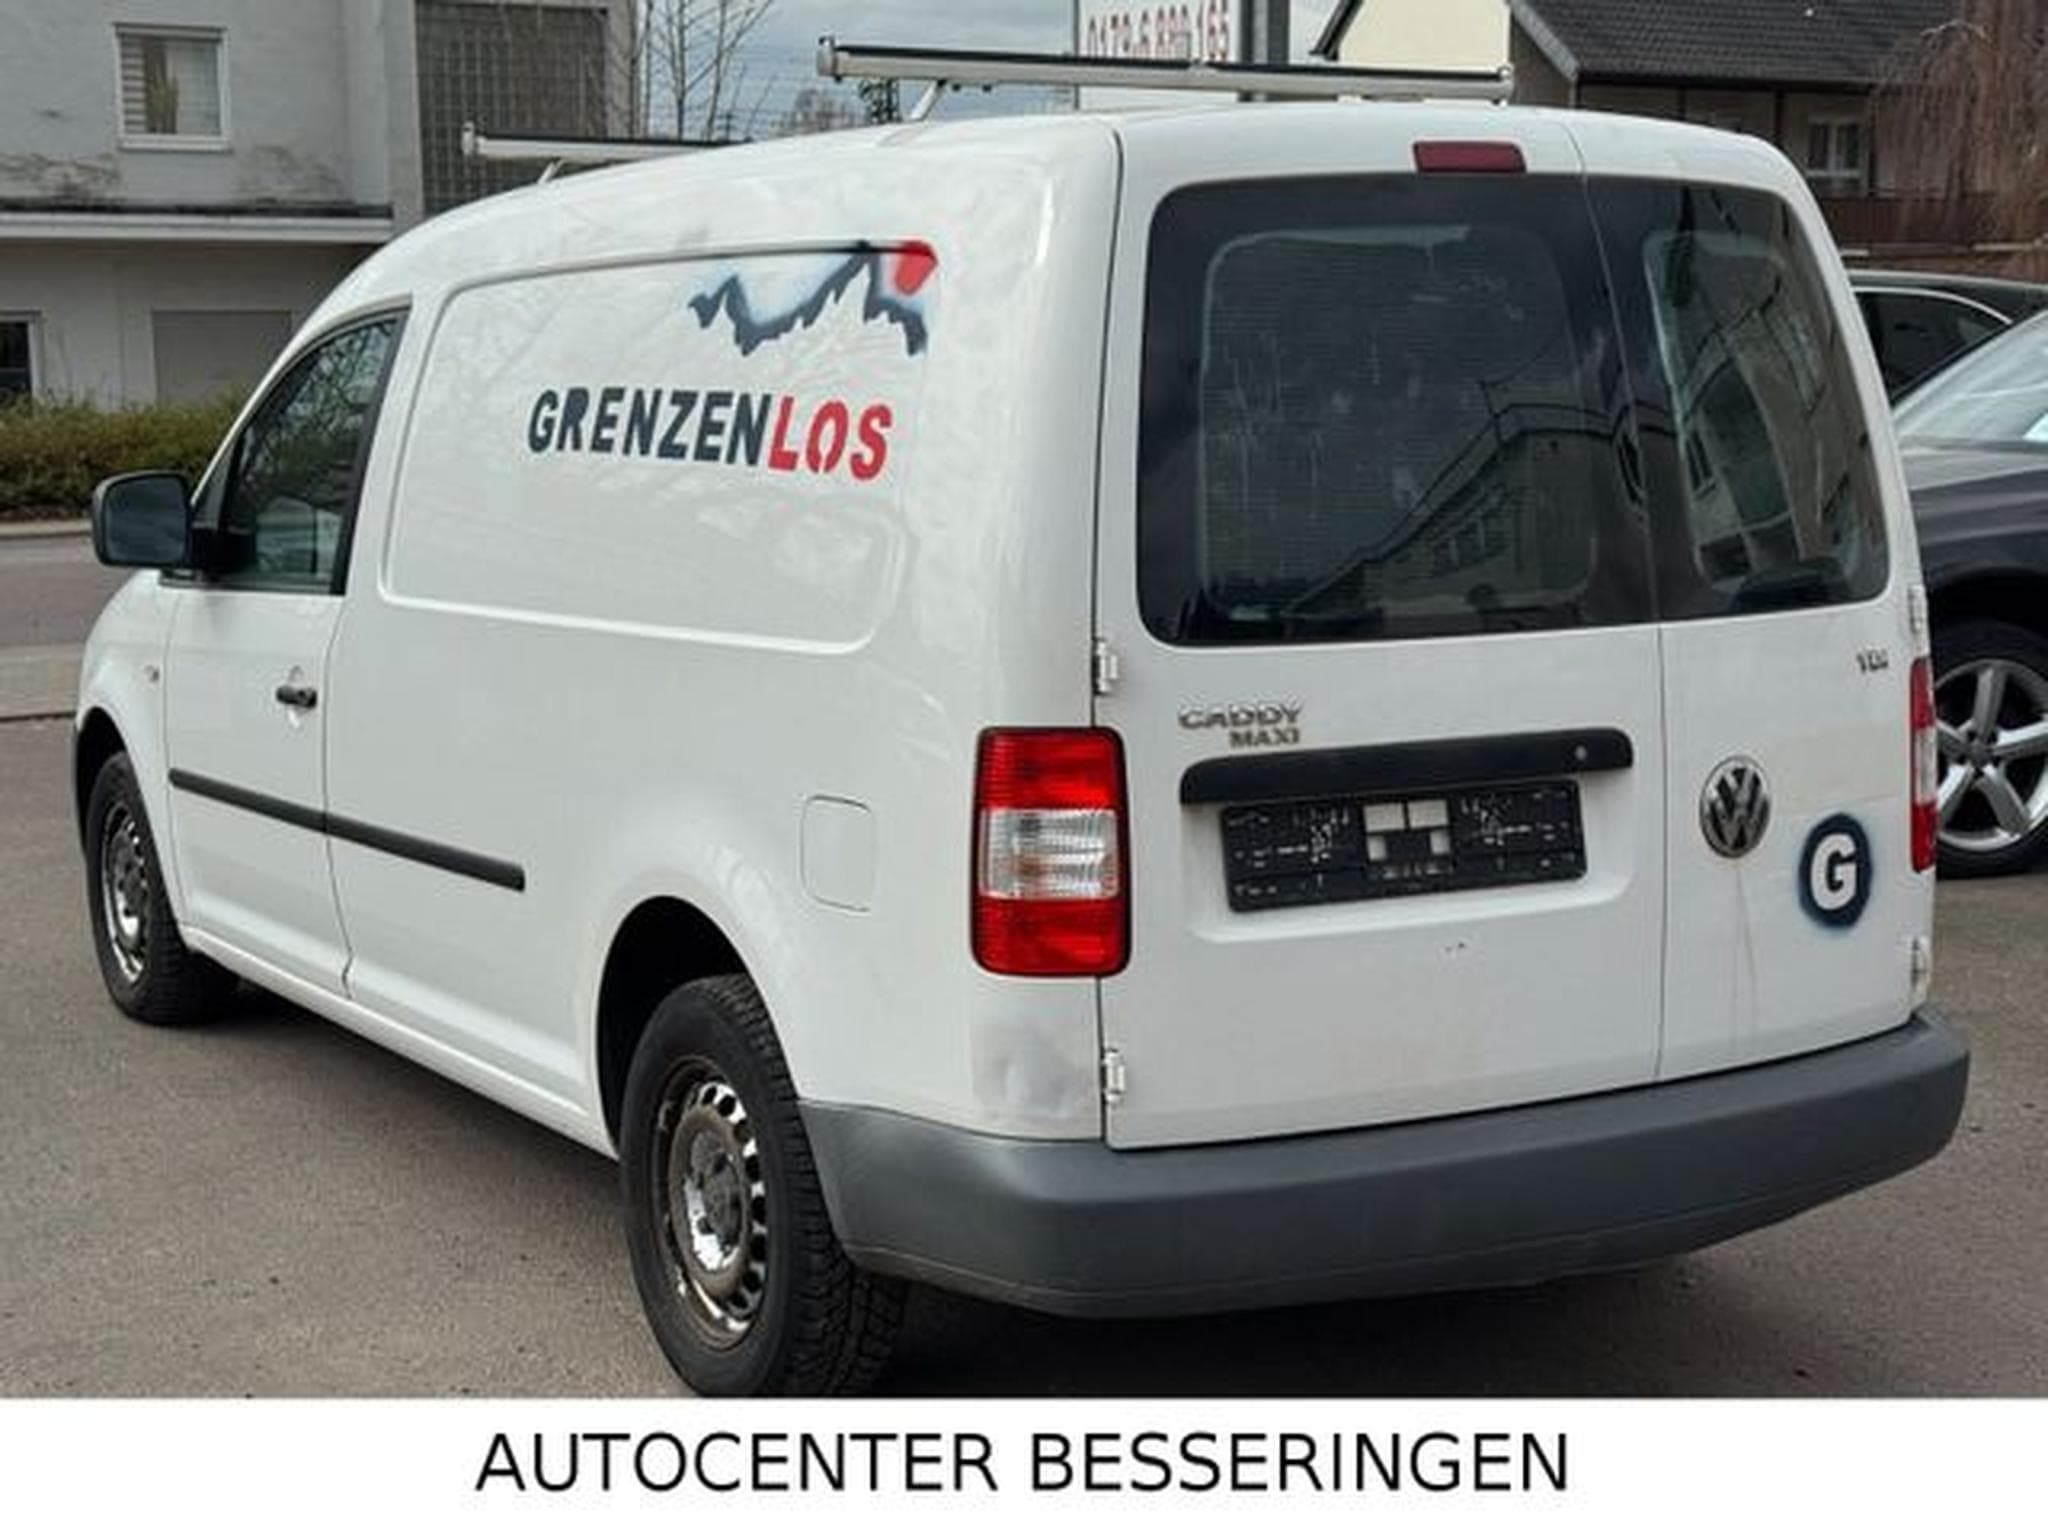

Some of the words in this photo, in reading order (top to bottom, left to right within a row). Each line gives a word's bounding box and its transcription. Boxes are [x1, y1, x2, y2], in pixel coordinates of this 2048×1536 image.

[527, 386, 893, 482] GRENZENLOS
[1178, 703, 1303, 730] CADDY
[1229, 727, 1300, 748] MAXI
[1810, 832, 1859, 911] G
